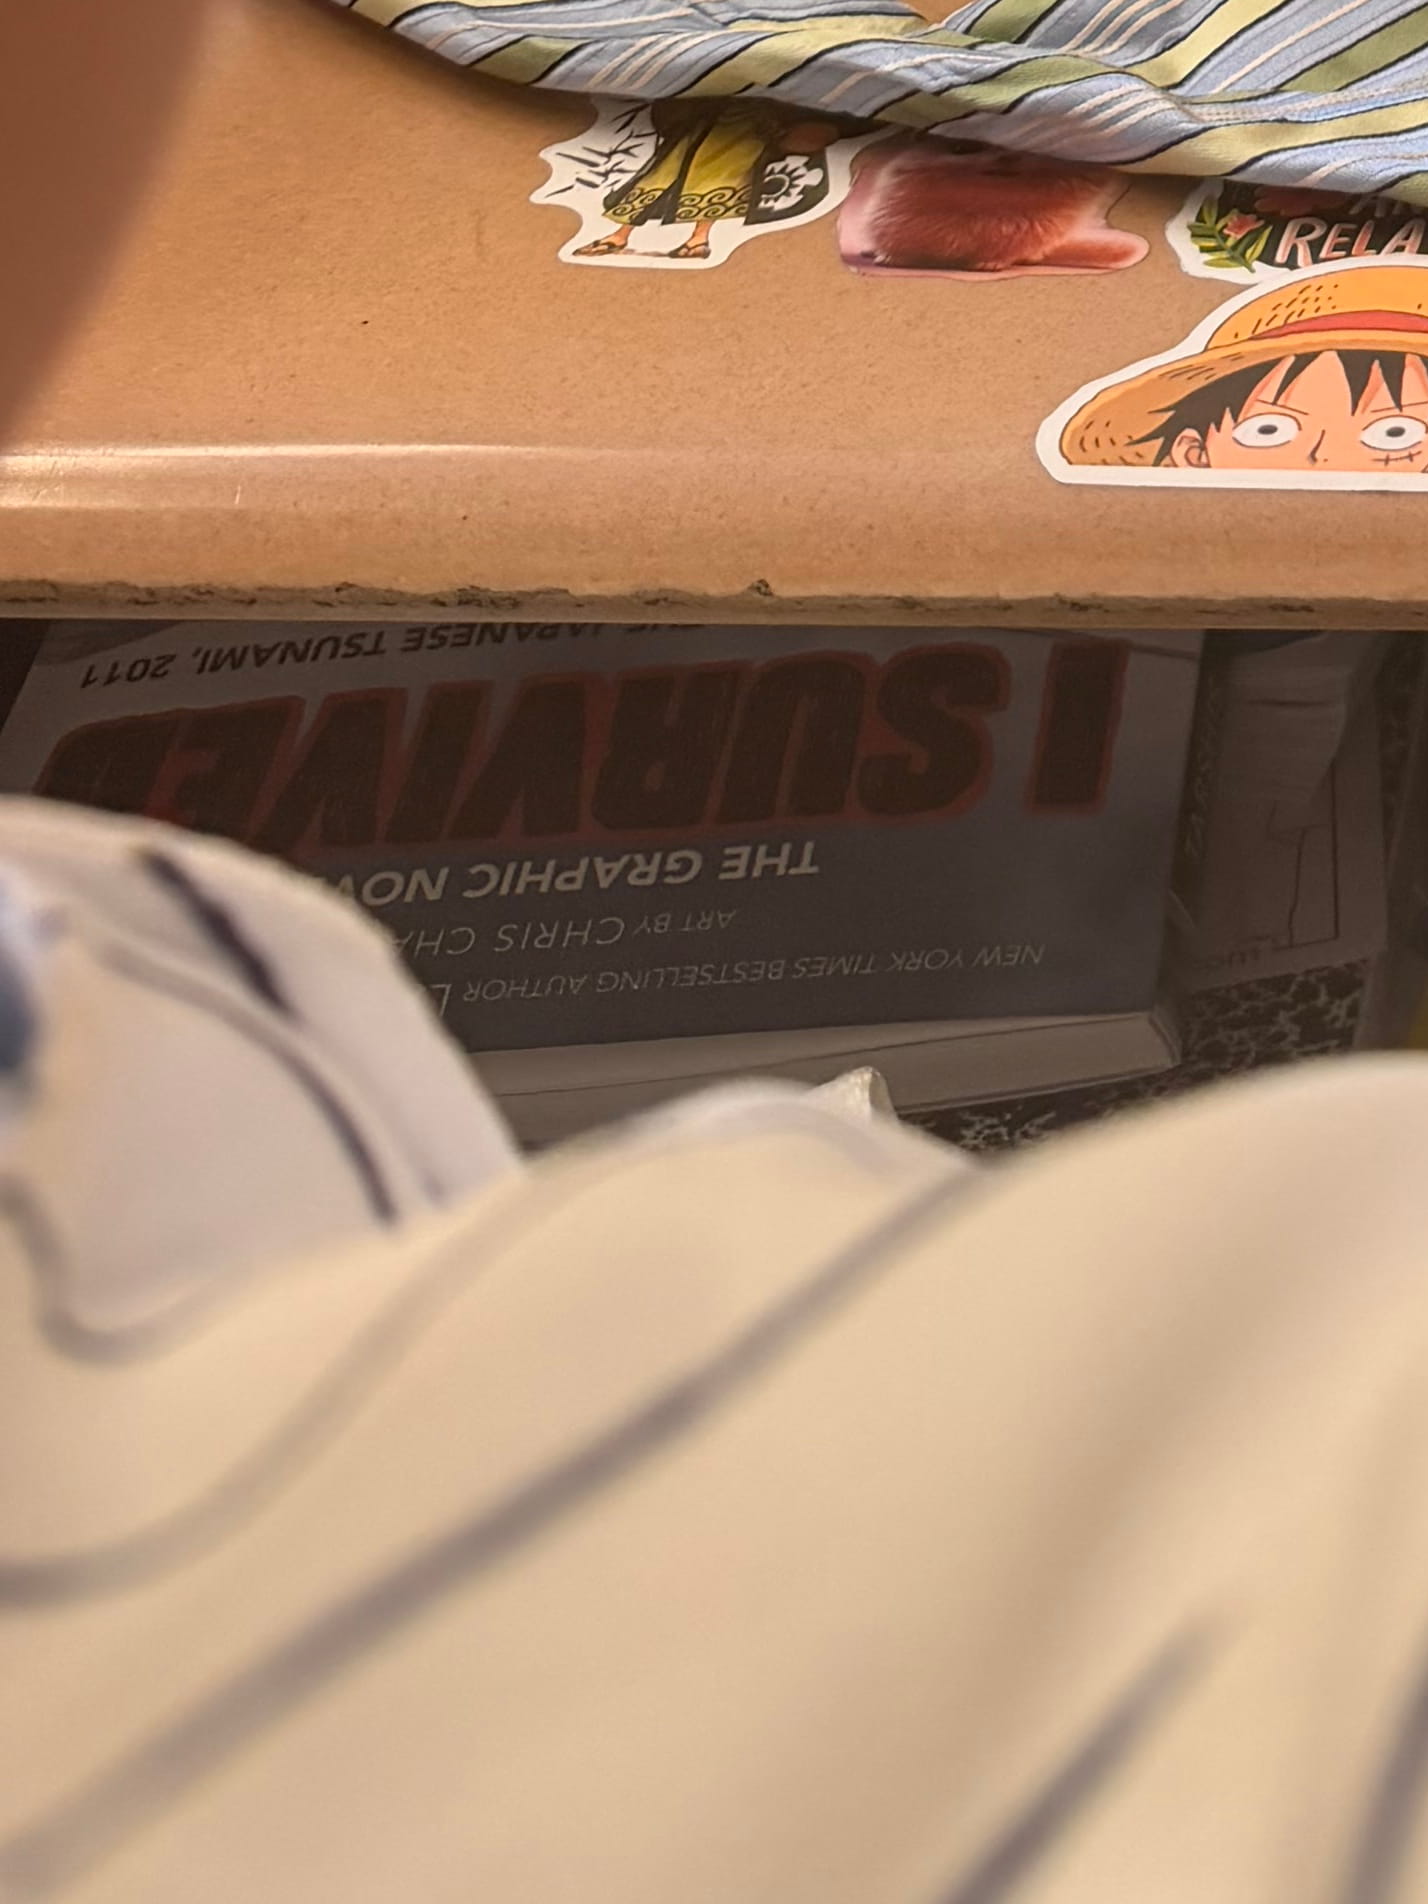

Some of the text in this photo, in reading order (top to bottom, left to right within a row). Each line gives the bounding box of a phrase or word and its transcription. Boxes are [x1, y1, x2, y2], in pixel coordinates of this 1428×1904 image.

[193, 629, 387, 675] TSUNAMI,
[80, 653, 175, 690] 2011
[1026, 638, 1133, 816] I
[463, 847, 701, 898] GRAPHIC
[719, 840, 821, 879] THE
[493, 915, 629, 951] CHRIS
[631, 913, 684, 937] BY
[690, 909, 737, 932] ART
[792, 952, 877, 980] TIMES
[889, 948, 964, 974] YORK
[972, 943, 1046, 968] NEW
[463, 973, 588, 1003] AUTHOR
[596, 957, 787, 995] BESTSELLING
